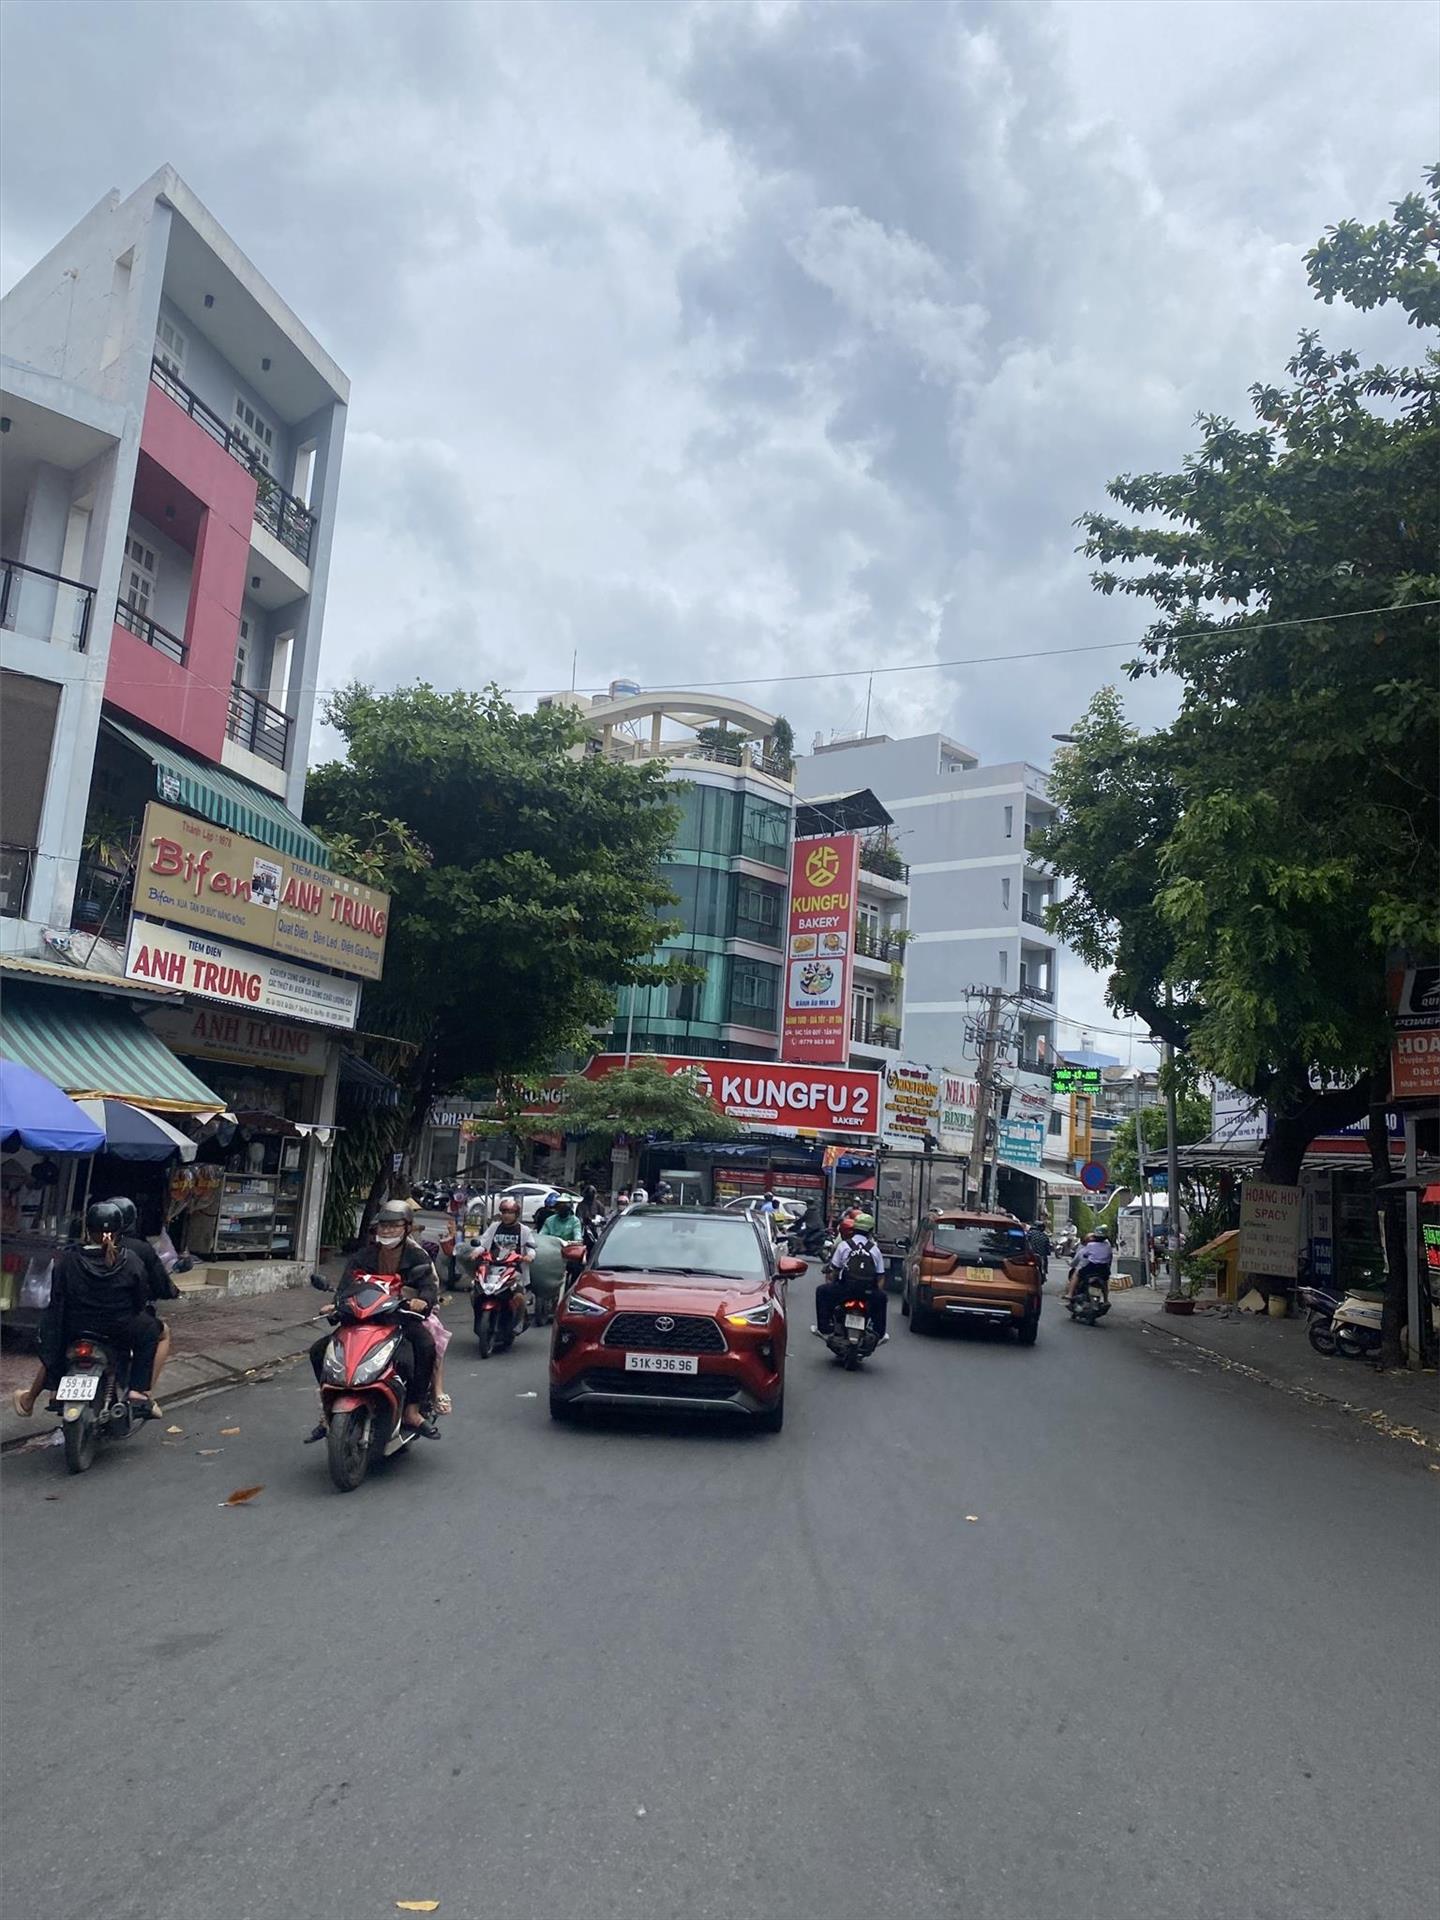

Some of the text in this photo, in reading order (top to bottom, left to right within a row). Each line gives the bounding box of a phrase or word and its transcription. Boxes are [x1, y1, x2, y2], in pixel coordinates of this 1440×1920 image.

[151, 837, 252, 902] Bifan
[281, 877, 386, 938] ANH TRUNG
[793, 893, 849, 913] KUNGFU
[799, 916, 840, 929] BAKERY
[132, 945, 186, 985] ANH
[193, 959, 262, 1002] TRUNG
[192, 1011, 239, 1042] ANH
[721, 1076, 848, 1112] KUNGFU
[852, 1088, 869, 1115] 2
[832, 1115, 864, 1127] BAKERY
[1254, 1207, 1288, 1222] SPACY
